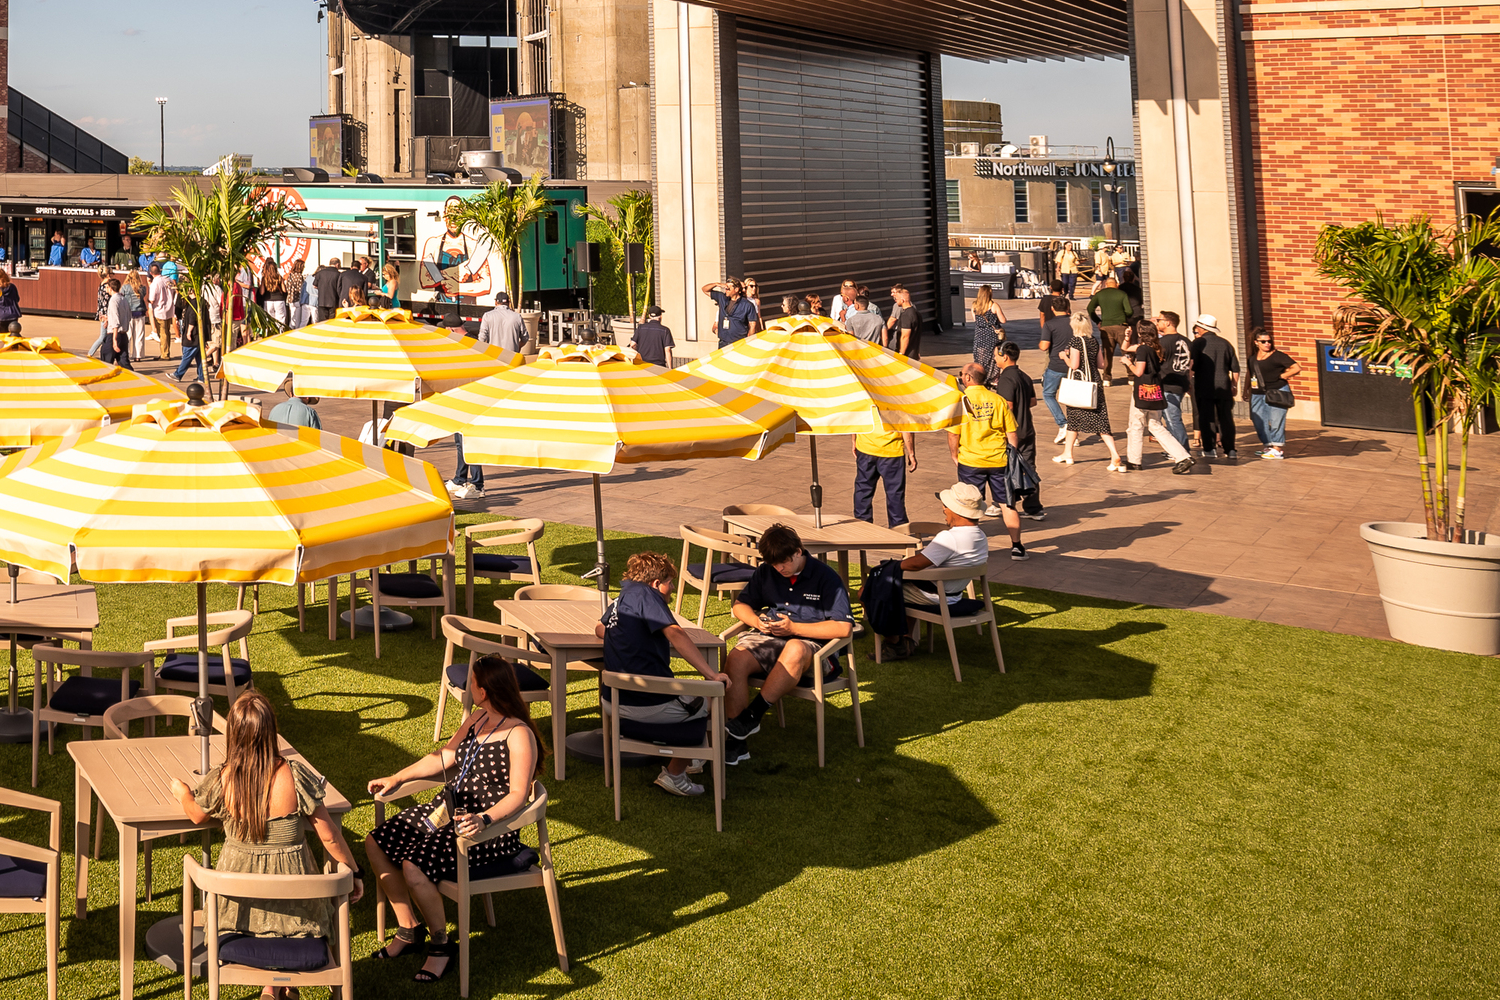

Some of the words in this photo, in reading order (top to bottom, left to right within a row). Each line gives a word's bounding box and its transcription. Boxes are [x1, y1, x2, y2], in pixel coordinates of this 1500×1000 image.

[993, 161, 1056, 176] Northwell
[1059, 166, 1069, 177] at
[35, 206, 57, 215] SPIRITS
[62, 207, 94, 216] COCKTAILS
[100, 208, 116, 217] BEER
